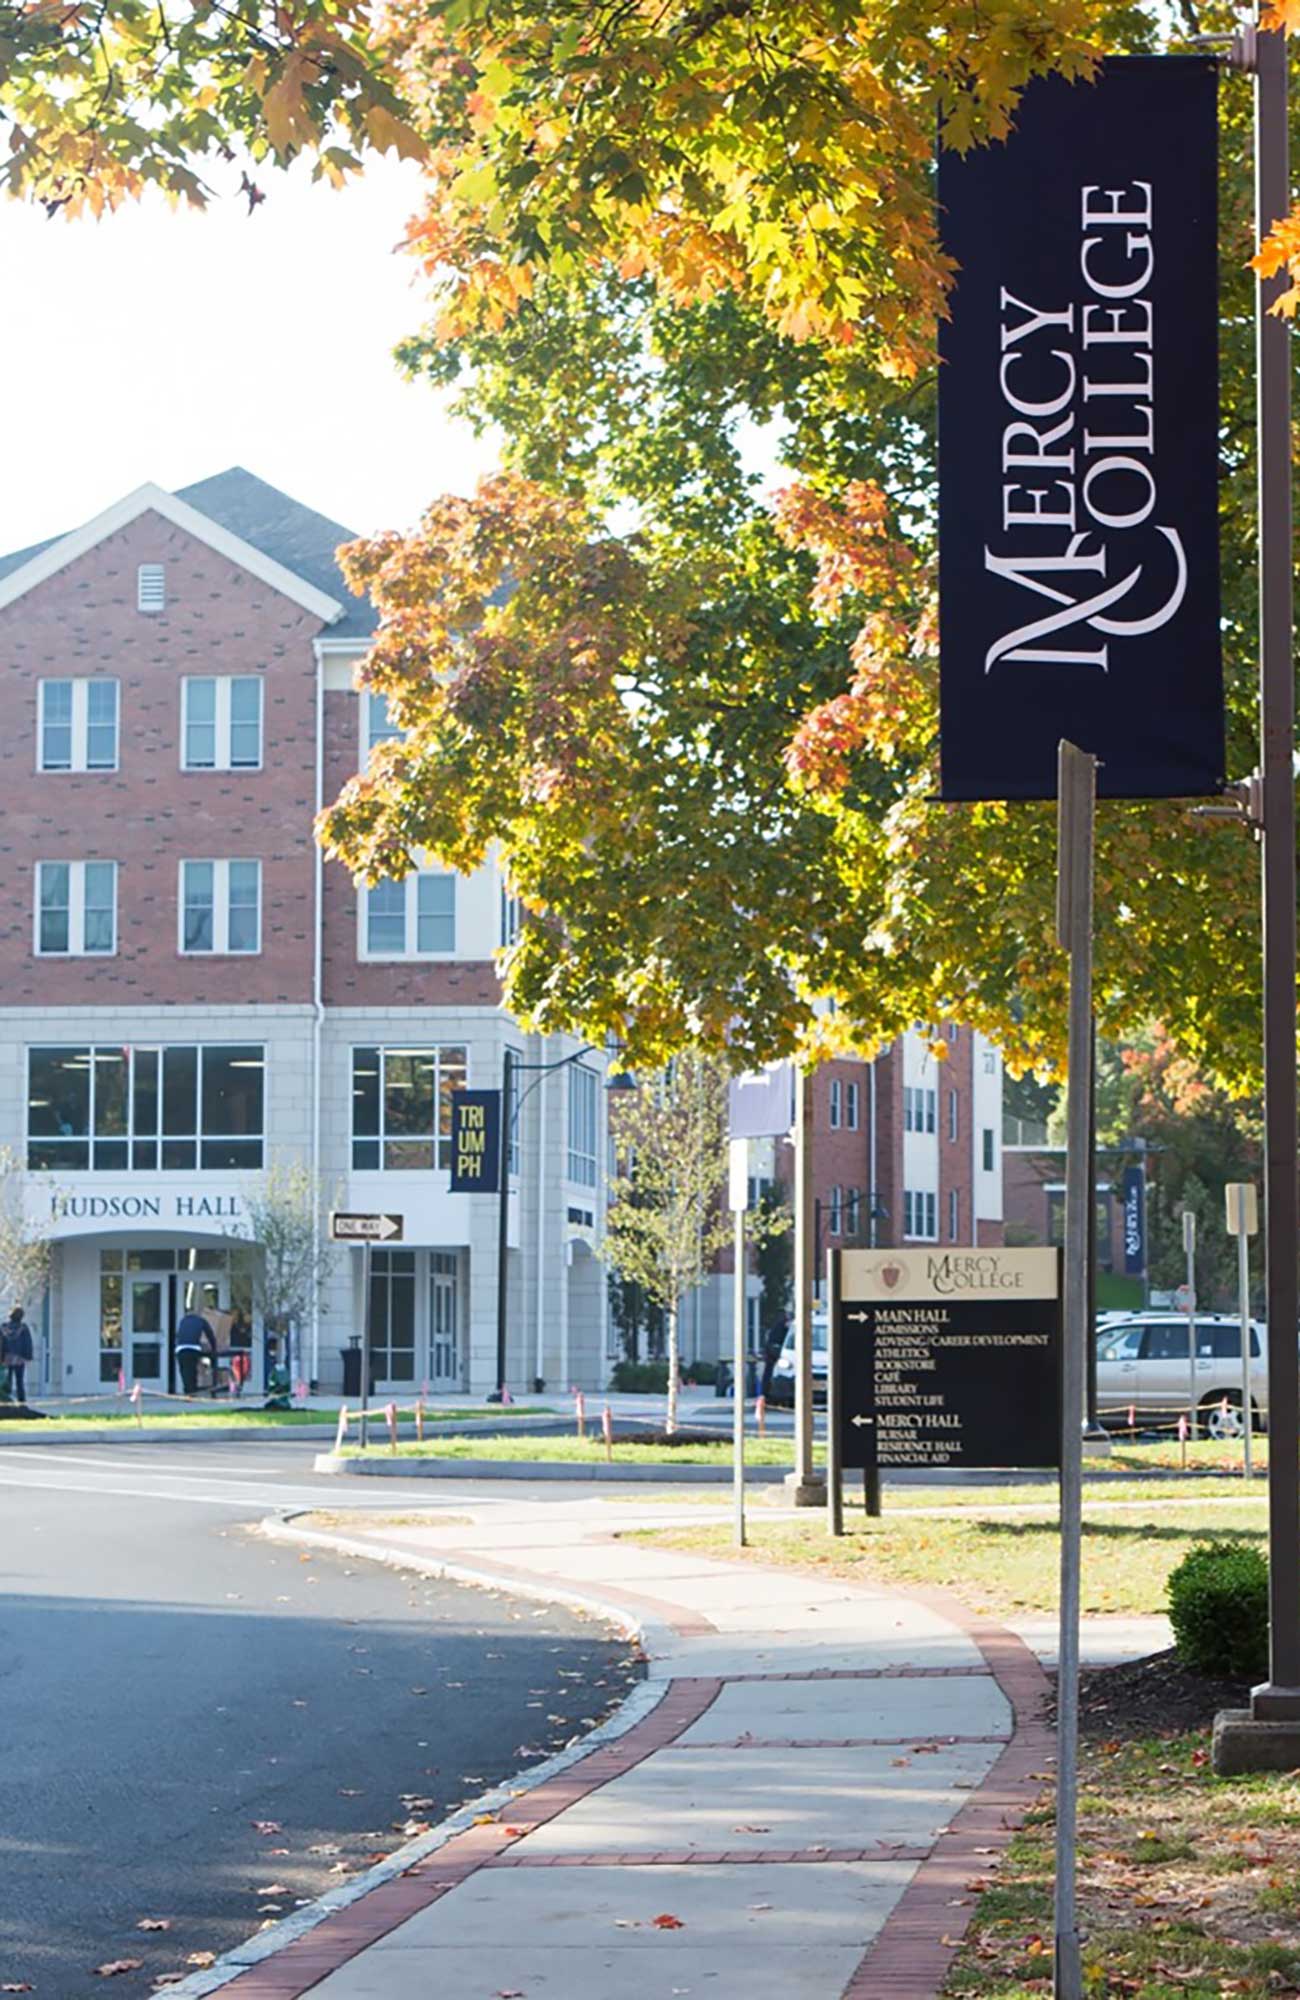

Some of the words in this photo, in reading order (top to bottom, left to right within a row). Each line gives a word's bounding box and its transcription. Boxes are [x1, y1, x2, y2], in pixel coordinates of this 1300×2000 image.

[1080, 180, 1188, 637] COLLEGE
[984, 285, 1108, 674] MERCY
[458, 1105, 484, 1128] TRI
[458, 1130, 485, 1153] UM
[457, 1155, 481, 1178] PH
[51, 1196, 160, 1217] HUDSON
[176, 1196, 241, 1217] HALL
[339, 1221, 358, 1233] ONE
[361, 1222, 380, 1232] WAY
[927, 1254, 1000, 1280] MERCY
[933, 1271, 1024, 1294] COLLEGE
[874, 1310, 912, 1322] MAIN
[914, 1310, 950, 1322] HALL
[874, 1325, 939, 1334] ADMISSIONS
[973, 1335, 1049, 1346] DEVELOPMENT
[874, 1348, 930, 1358] ATHLETICS
[874, 1360, 936, 1370] BOOKSTORE
[874, 1384, 918, 1394] LIBRARY
[874, 1396, 923, 1406] STUDENT
[924, 1396, 944, 1405] LIFE
[876, 1414, 925, 1428] MERCY
[926, 1414, 962, 1428] HALL
[876, 1430, 918, 1439] BURSAR
[876, 1442, 933, 1452] RESIDENCE
[935, 1441, 963, 1452] HALL
[876, 1454, 930, 1463] FINANCIAL
[931, 1453, 950, 1463] AID
